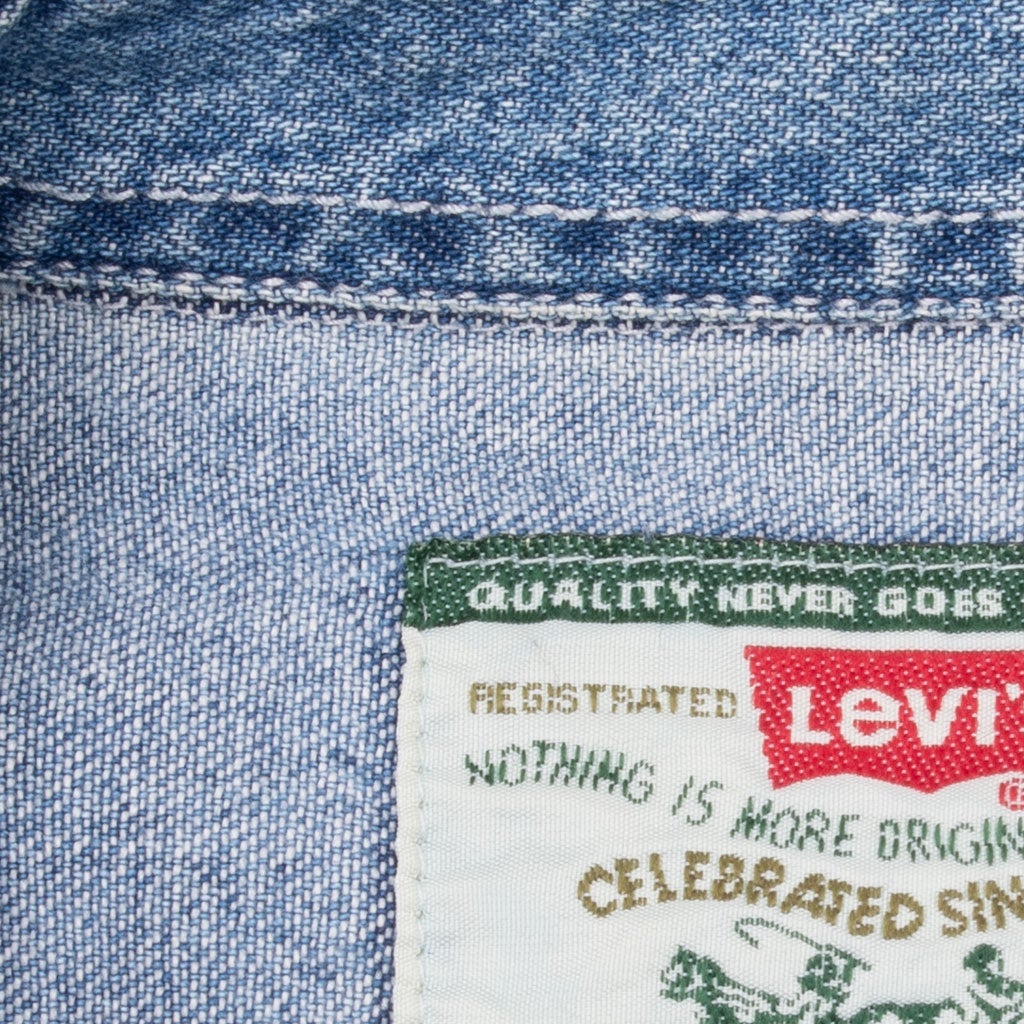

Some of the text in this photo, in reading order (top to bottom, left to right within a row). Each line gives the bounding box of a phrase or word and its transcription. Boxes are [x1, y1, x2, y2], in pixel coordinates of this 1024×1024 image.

[466, 581, 699, 613] QUALITY
[717, 584, 858, 616] NEVER
[876, 587, 1001, 618] GOES
[469, 682, 738, 718] REGISTRATED
[465, 740, 655, 804] NOTHING
[672, 776, 724, 825] IS
[730, 796, 860, 858] MORE
[577, 851, 924, 940] CELEBRATED
